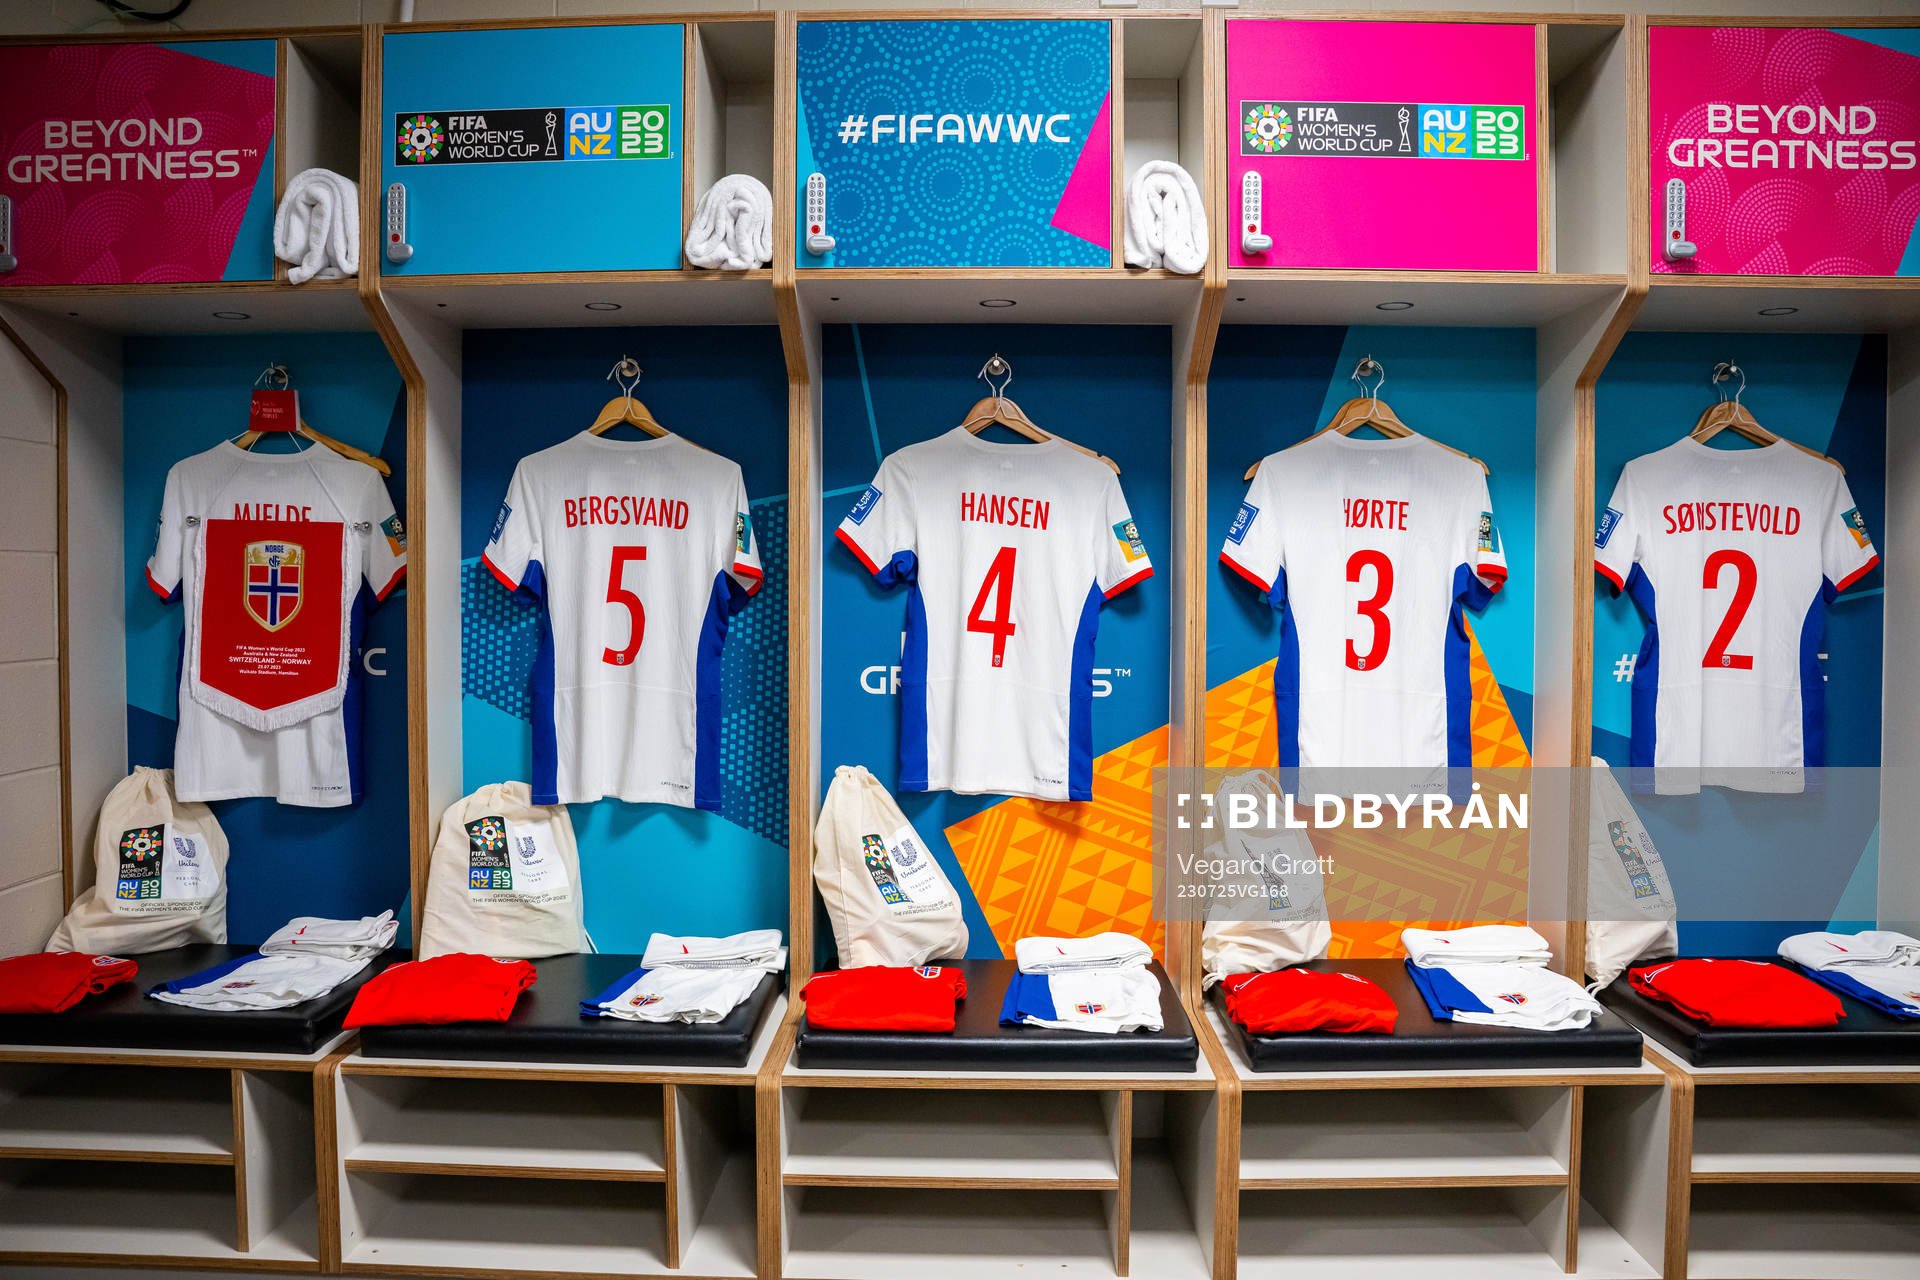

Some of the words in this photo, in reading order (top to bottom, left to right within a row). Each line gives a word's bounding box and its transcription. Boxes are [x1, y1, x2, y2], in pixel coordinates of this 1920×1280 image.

[448, 115, 488, 130] FIFA
[569, 112, 612, 133] AU
[622, 111, 664, 132] 20
[1297, 107, 1338, 122] FIFA
[1423, 109, 1466, 131] AU
[1476, 111, 1519, 132] 20
[1707, 104, 1877, 135] BEYOND
[44, 117, 203, 149] BEYOND
[838, 113, 1071, 144] #FIFAWWC
[1297, 123, 1377, 137] WOMEN'S
[448, 130, 525, 145] WOMEN'S
[569, 134, 612, 156] NZ
[622, 133, 664, 155] 23
[1298, 138, 1357, 151] WORLD
[1359, 138, 1392, 152] CUP
[1423, 132, 1466, 153] NZ
[1476, 133, 1519, 155] 23
[448, 144, 505, 159] WORLD
[507, 143, 540, 157] CUP
[1667, 138, 1917, 170] GREATNESS
[563, 495, 690, 530] BERGSVAND
[961, 492, 1051, 531] HANSEN
[1662, 501, 1801, 536] SØNSTEVOLD
[264, 544, 285, 554] NORGE
[602, 545, 648, 667] 5
[966, 546, 1017, 668] 4
[1345, 549, 1395, 673] 3
[1701, 549, 1758, 671] 2
[228, 656, 276, 664] SWITZERLAND
[120, 871, 141, 879] WORLD
[470, 870, 490, 879] AU
[492, 870, 511, 880] 20
[119, 881, 139, 891] AU
[141, 879, 160, 889] 20
[470, 879, 489, 888] NZ
[492, 879, 511, 889] 23
[881, 884, 898, 896] AU
[1635, 885, 1654, 897] NZ
[118, 889, 137, 899] NZ
[140, 888, 160, 898] 23
[884, 892, 903, 903] NZ
